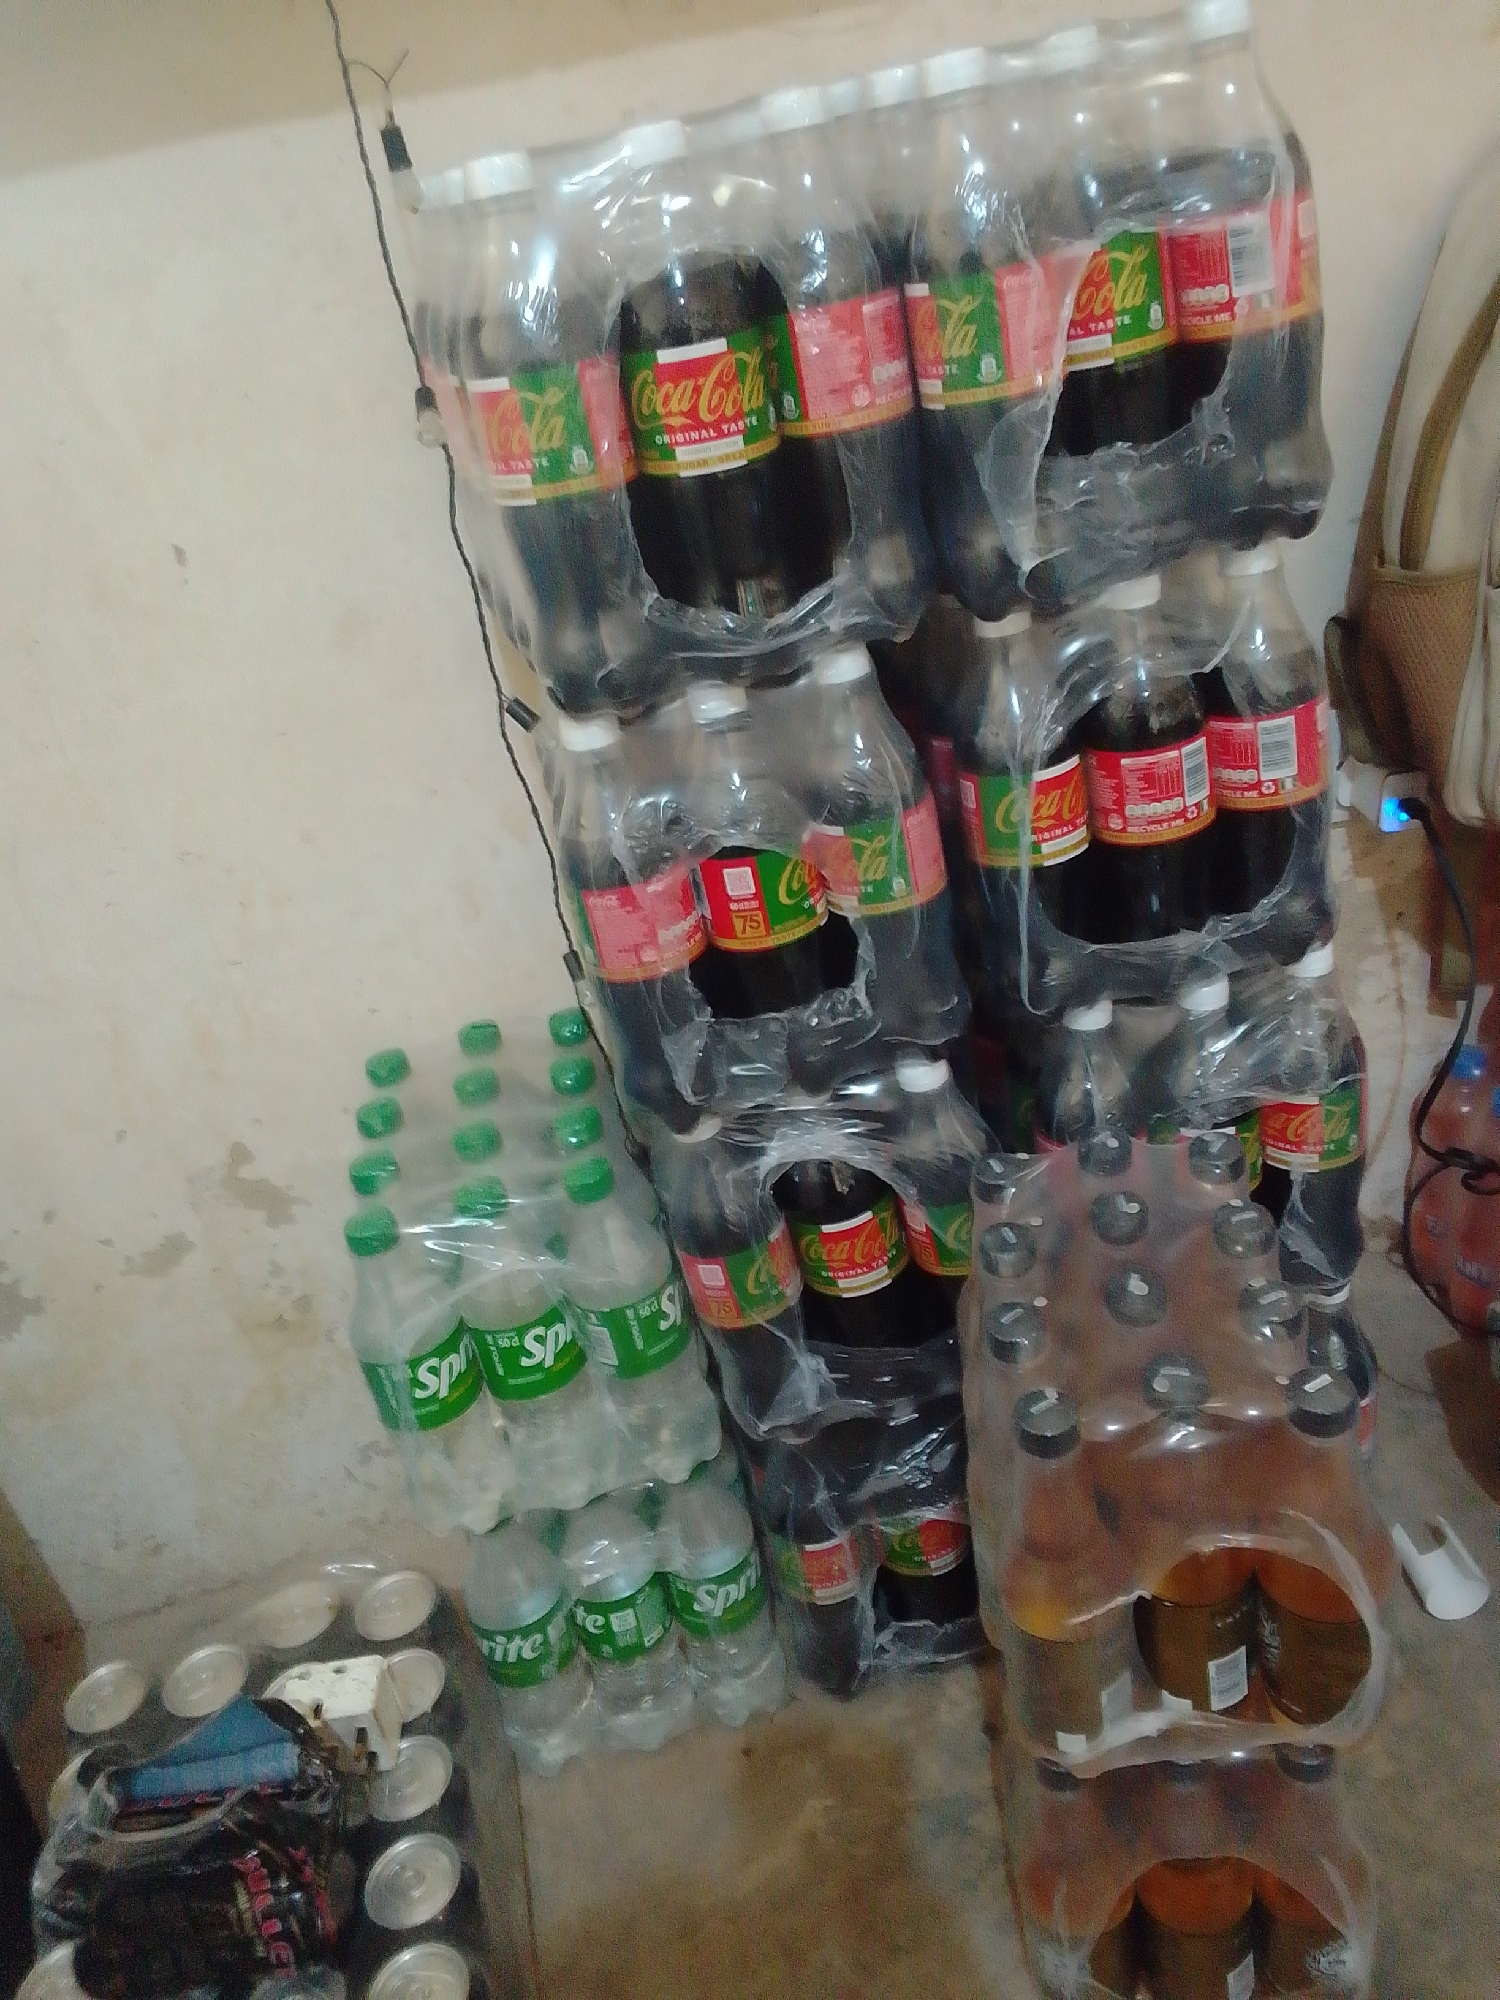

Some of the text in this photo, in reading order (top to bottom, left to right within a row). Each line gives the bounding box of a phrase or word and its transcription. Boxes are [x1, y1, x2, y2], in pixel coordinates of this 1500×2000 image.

[1089, 314, 1132, 333] TASTE
[631, 346, 765, 431] Coca-Cola
[655, 415, 758, 446] ORIGINAL TASTE
[734, 913, 761, 935] 75
[799, 1202, 900, 1266] Coca-Cola
